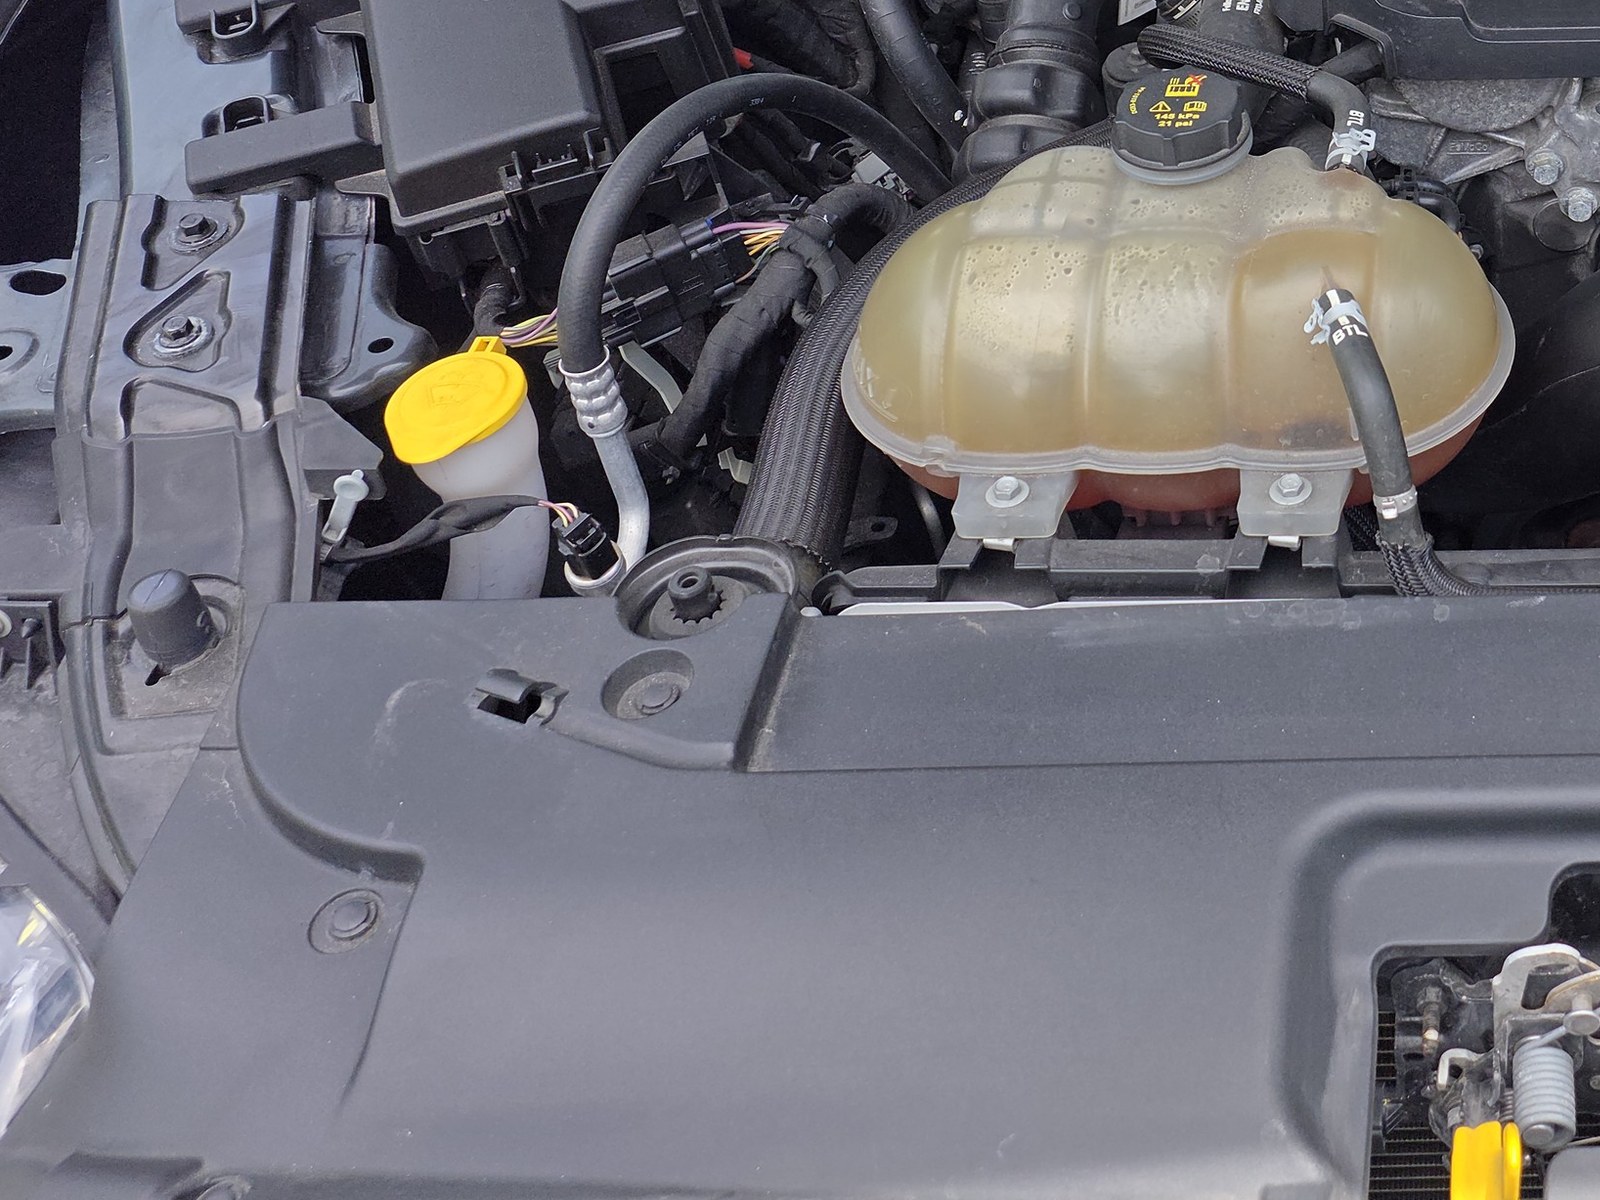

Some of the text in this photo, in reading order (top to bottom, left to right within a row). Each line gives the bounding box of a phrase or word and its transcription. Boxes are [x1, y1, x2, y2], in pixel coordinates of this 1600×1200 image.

[1158, 120, 1193, 128] 21 psi
[1346, 109, 1365, 127] BTL
[1332, 324, 1369, 345] BTL
